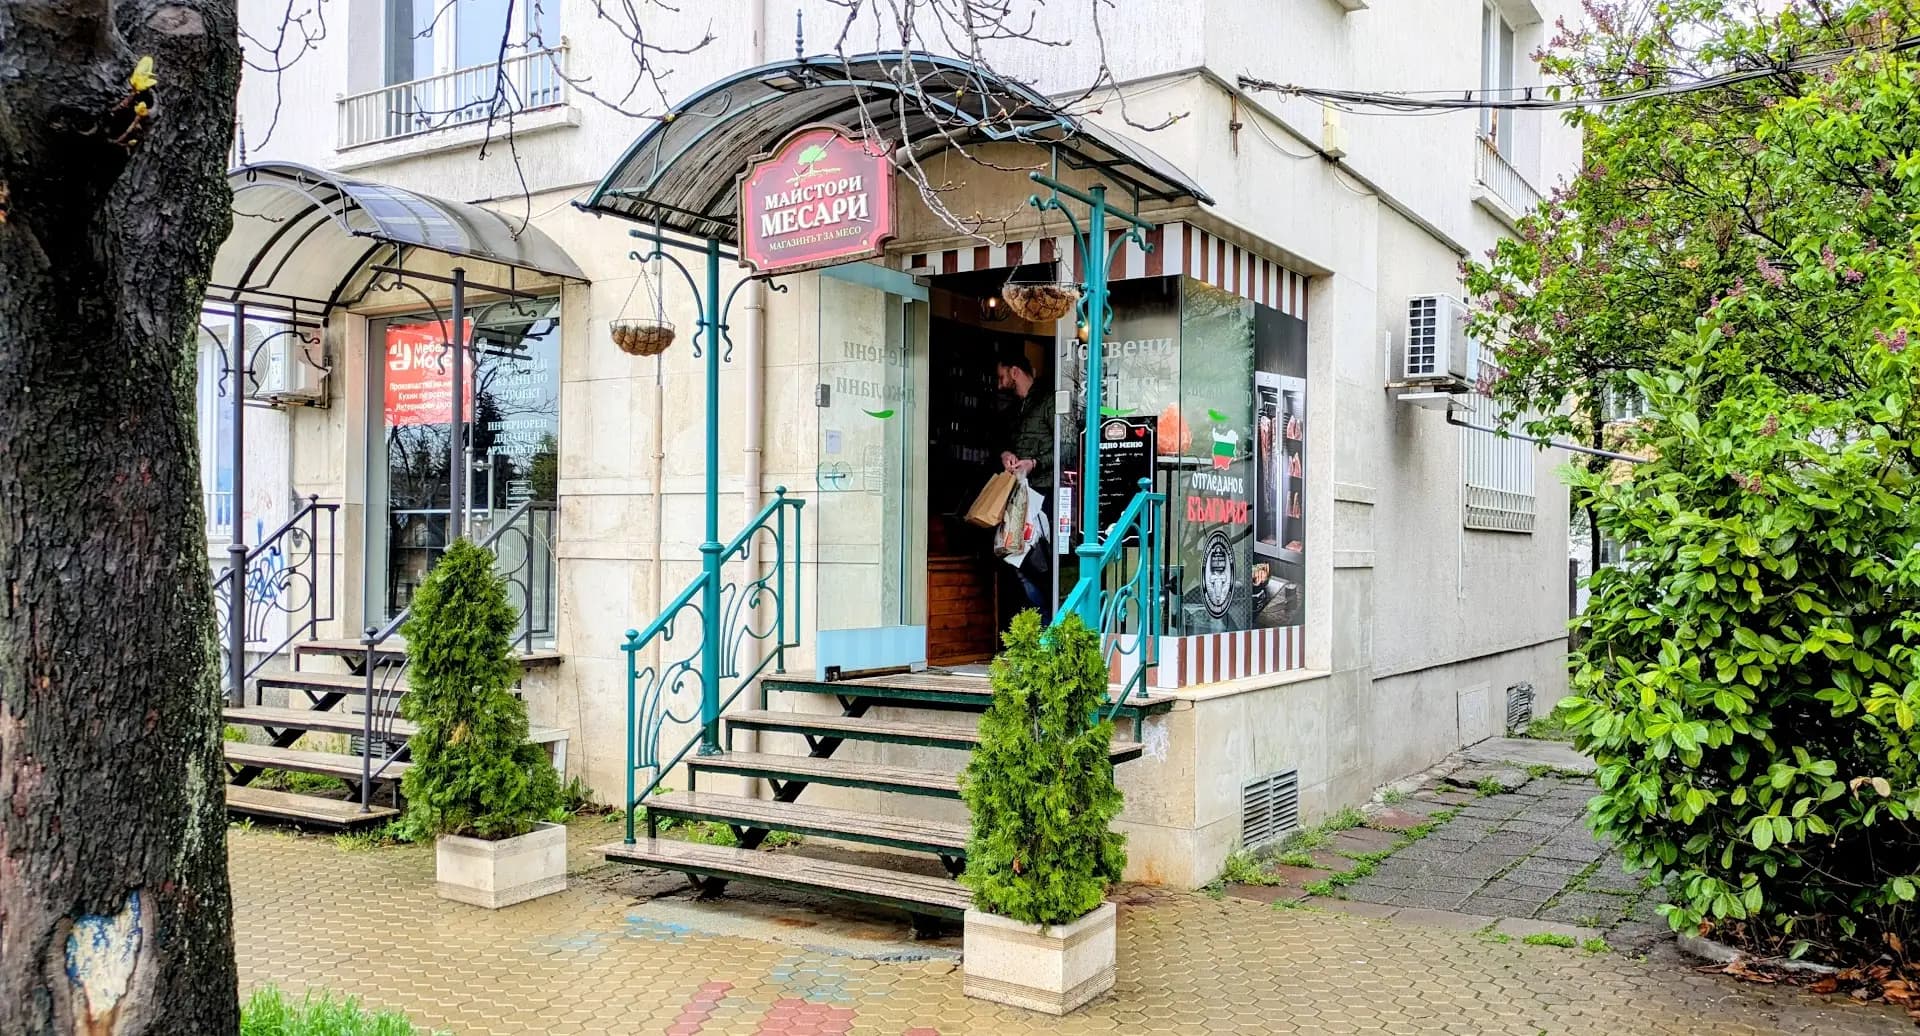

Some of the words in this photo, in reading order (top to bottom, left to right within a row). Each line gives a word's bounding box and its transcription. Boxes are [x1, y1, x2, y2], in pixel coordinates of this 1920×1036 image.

[764, 175, 863, 211] МАЙСТОРИ
[760, 193, 869, 238] МЕСАРИ
[769, 233, 822, 249] МАГАЗИНЪТ
[823, 231, 836, 241] ЗА
[836, 226, 862, 238] МЕСО
[487, 419, 548, 431] ИНТЕРИОРЕН
[486, 443, 549, 455] АРХИТЕКТУРА
[1099, 442, 1118, 450] ЕДНО
[1119, 441, 1143, 449] МЕНЮ
[1187, 496, 1248, 524] БЪЛГАРИЯ
